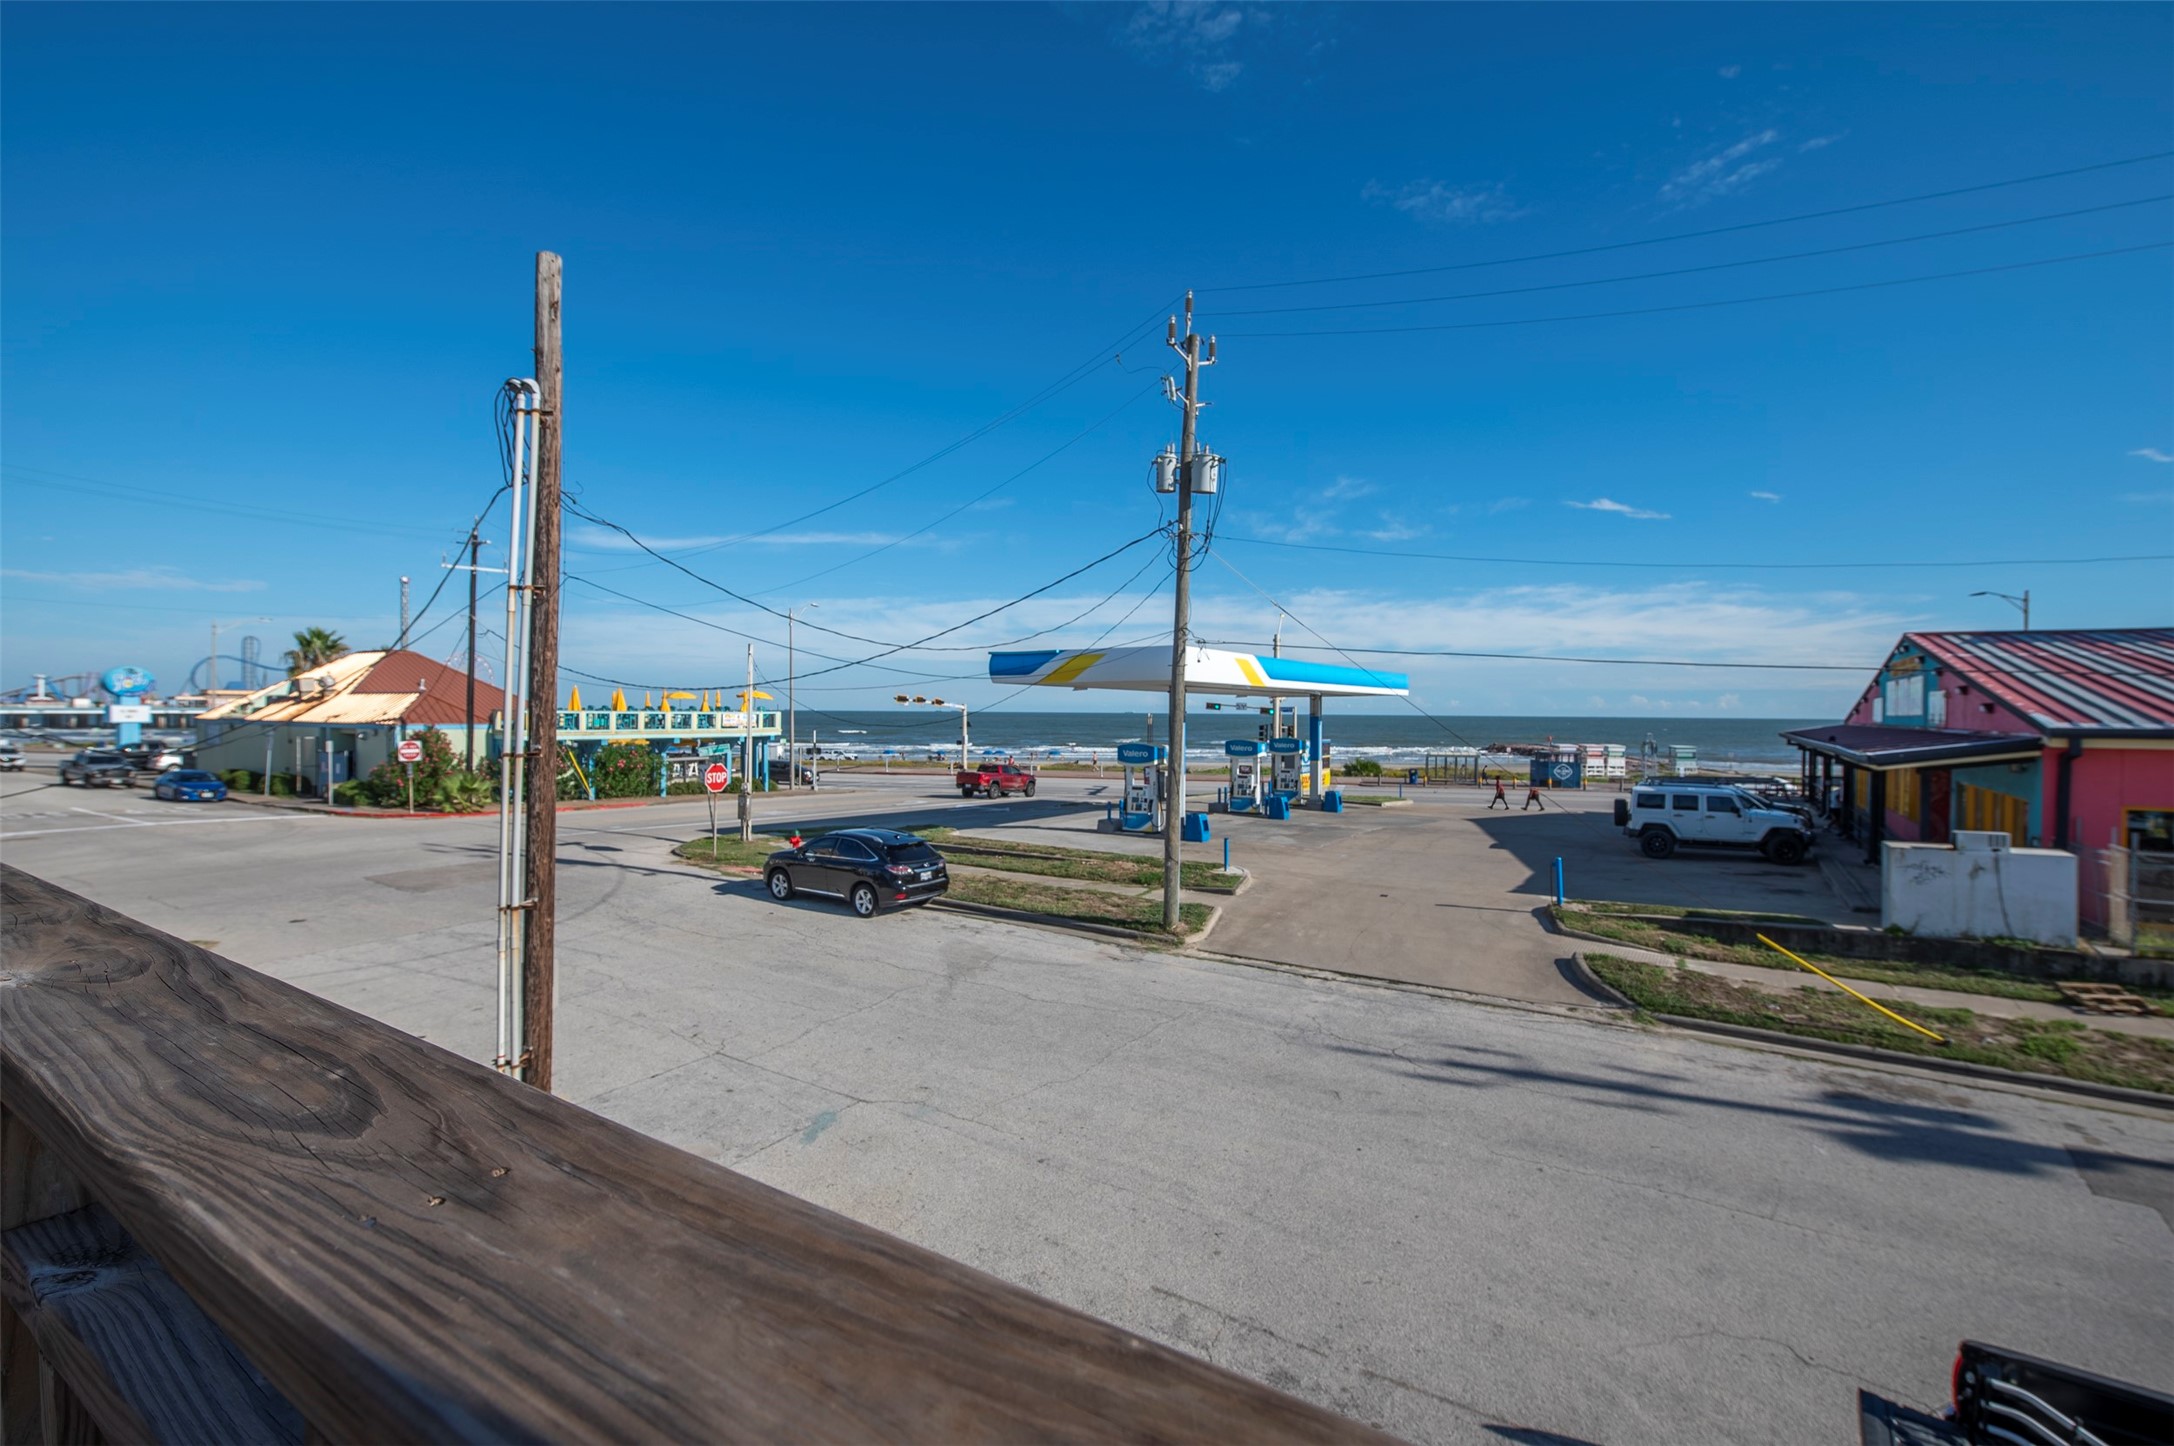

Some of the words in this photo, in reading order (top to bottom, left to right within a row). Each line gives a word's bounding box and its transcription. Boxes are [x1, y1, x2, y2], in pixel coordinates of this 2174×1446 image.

[1230, 744, 1253, 752] Valero
[1122, 749, 1149, 758] Valero
[707, 772, 727, 784] STOP
